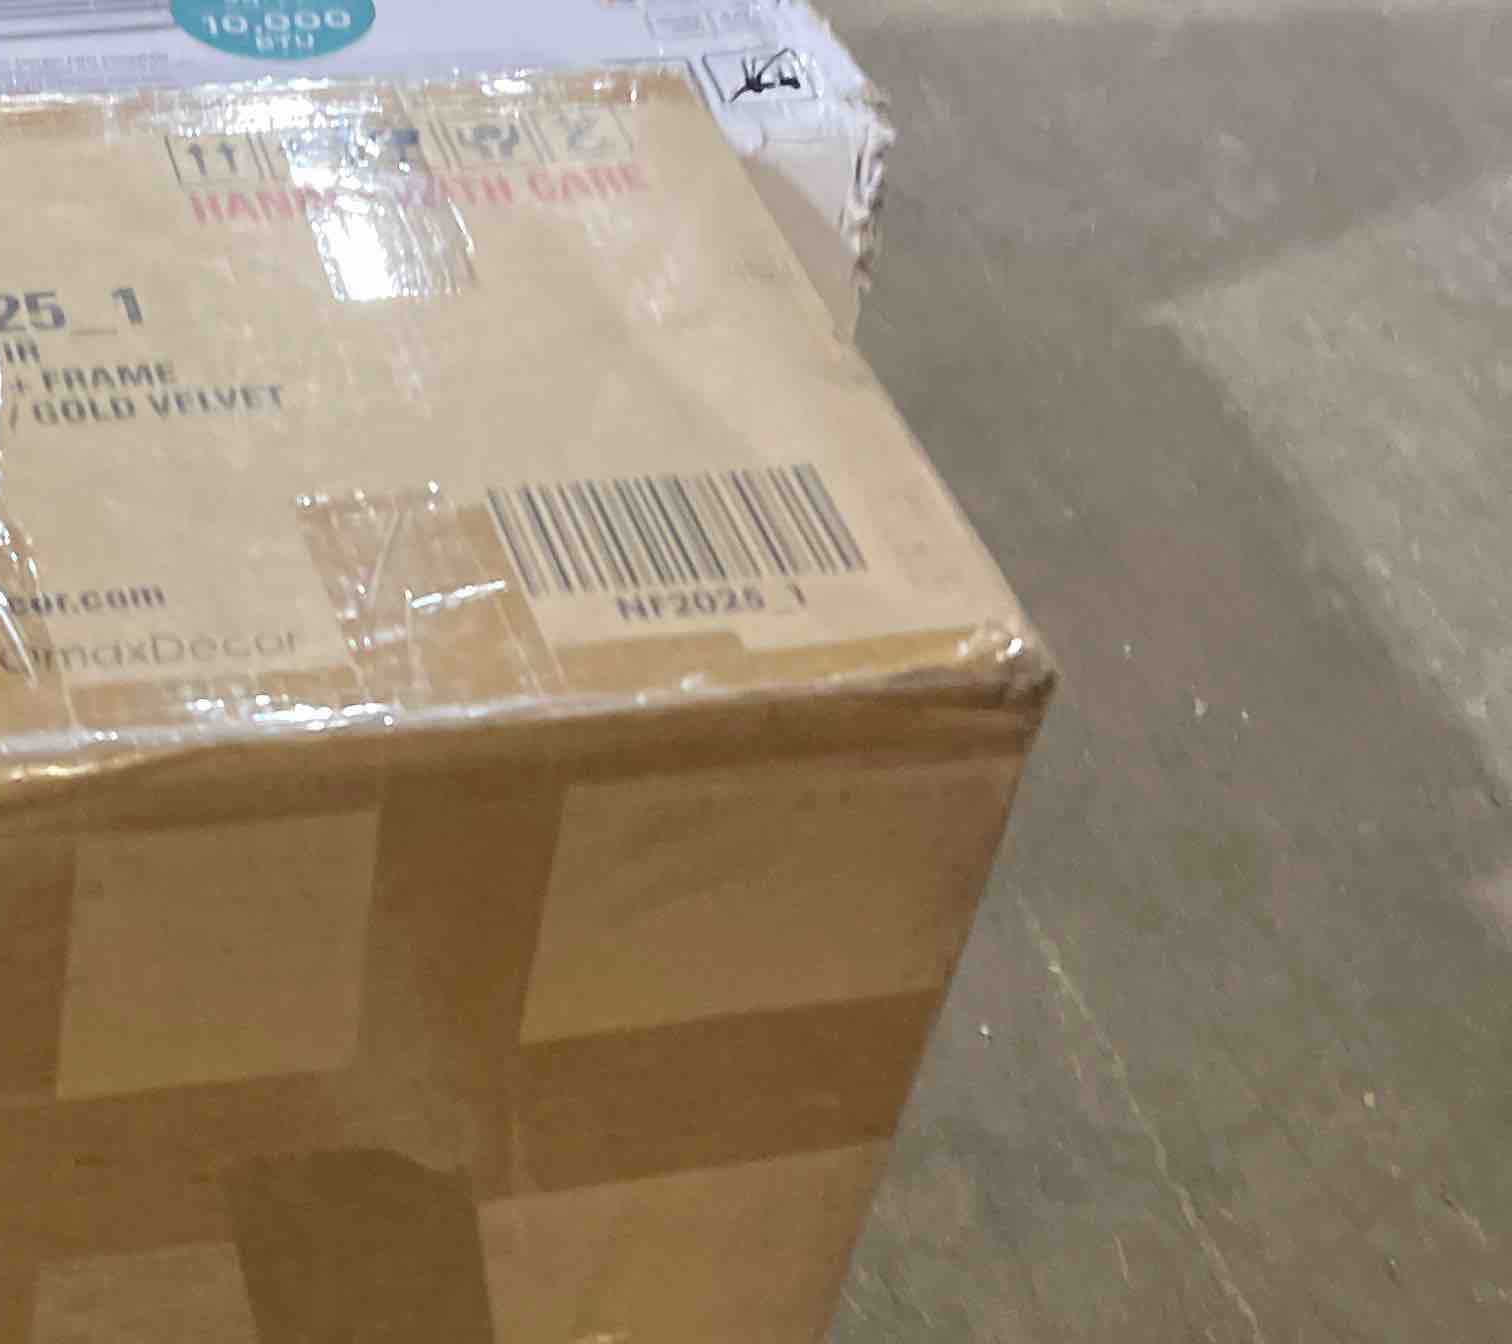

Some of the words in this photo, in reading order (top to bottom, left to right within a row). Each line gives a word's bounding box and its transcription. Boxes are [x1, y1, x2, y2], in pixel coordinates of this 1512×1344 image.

[527, 162, 652, 203] CARE
[41, 361, 178, 394] FRAME
[32, 394, 137, 426] GOLD
[147, 385, 285, 420] VELVET
